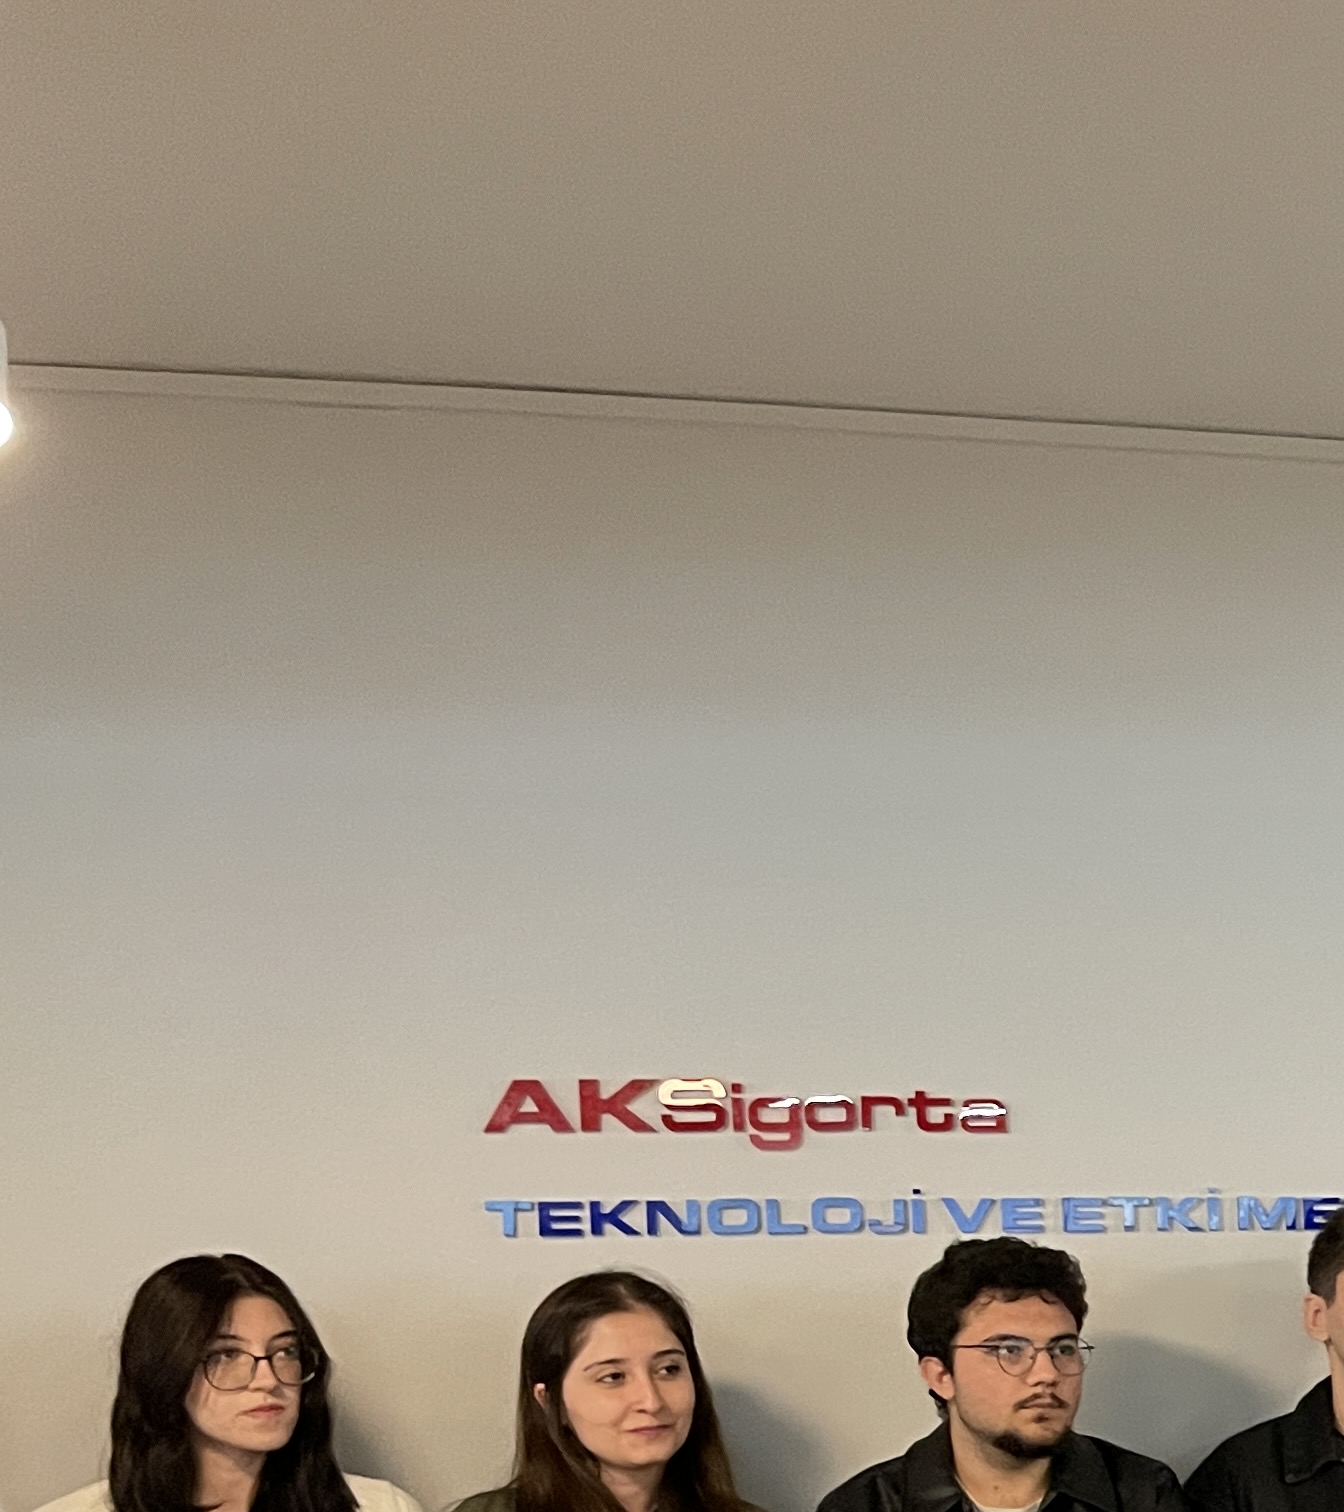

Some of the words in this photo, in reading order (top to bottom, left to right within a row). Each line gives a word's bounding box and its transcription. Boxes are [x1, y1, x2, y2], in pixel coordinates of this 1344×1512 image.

[484, 1077, 1009, 1151] AKSigorta
[485, 1188, 927, 1237] TEKNOLOJİ
[942, 1197, 1046, 1234] VE
[1062, 1187, 1222, 1233] ETKİ
